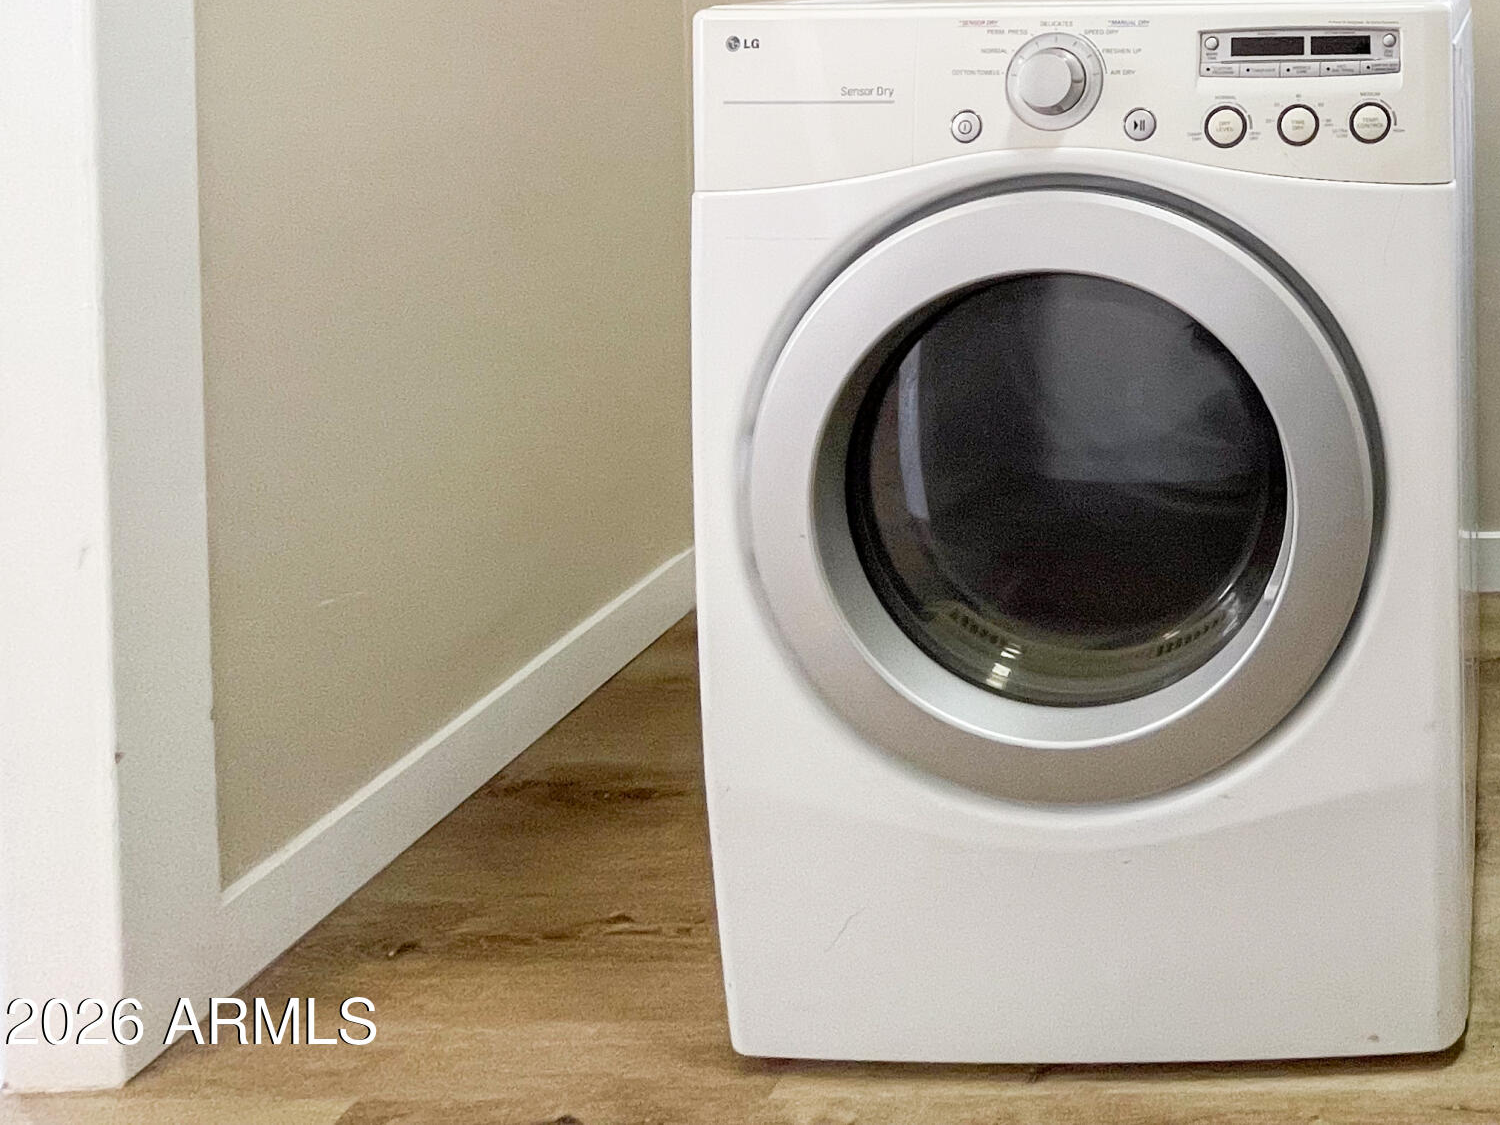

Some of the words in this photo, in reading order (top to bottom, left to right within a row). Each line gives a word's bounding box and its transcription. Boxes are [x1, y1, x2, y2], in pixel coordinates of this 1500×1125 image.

[743, 38, 760, 49] LG
[840, 86, 874, 97] Sensor
[876, 86, 894, 98] Dry
